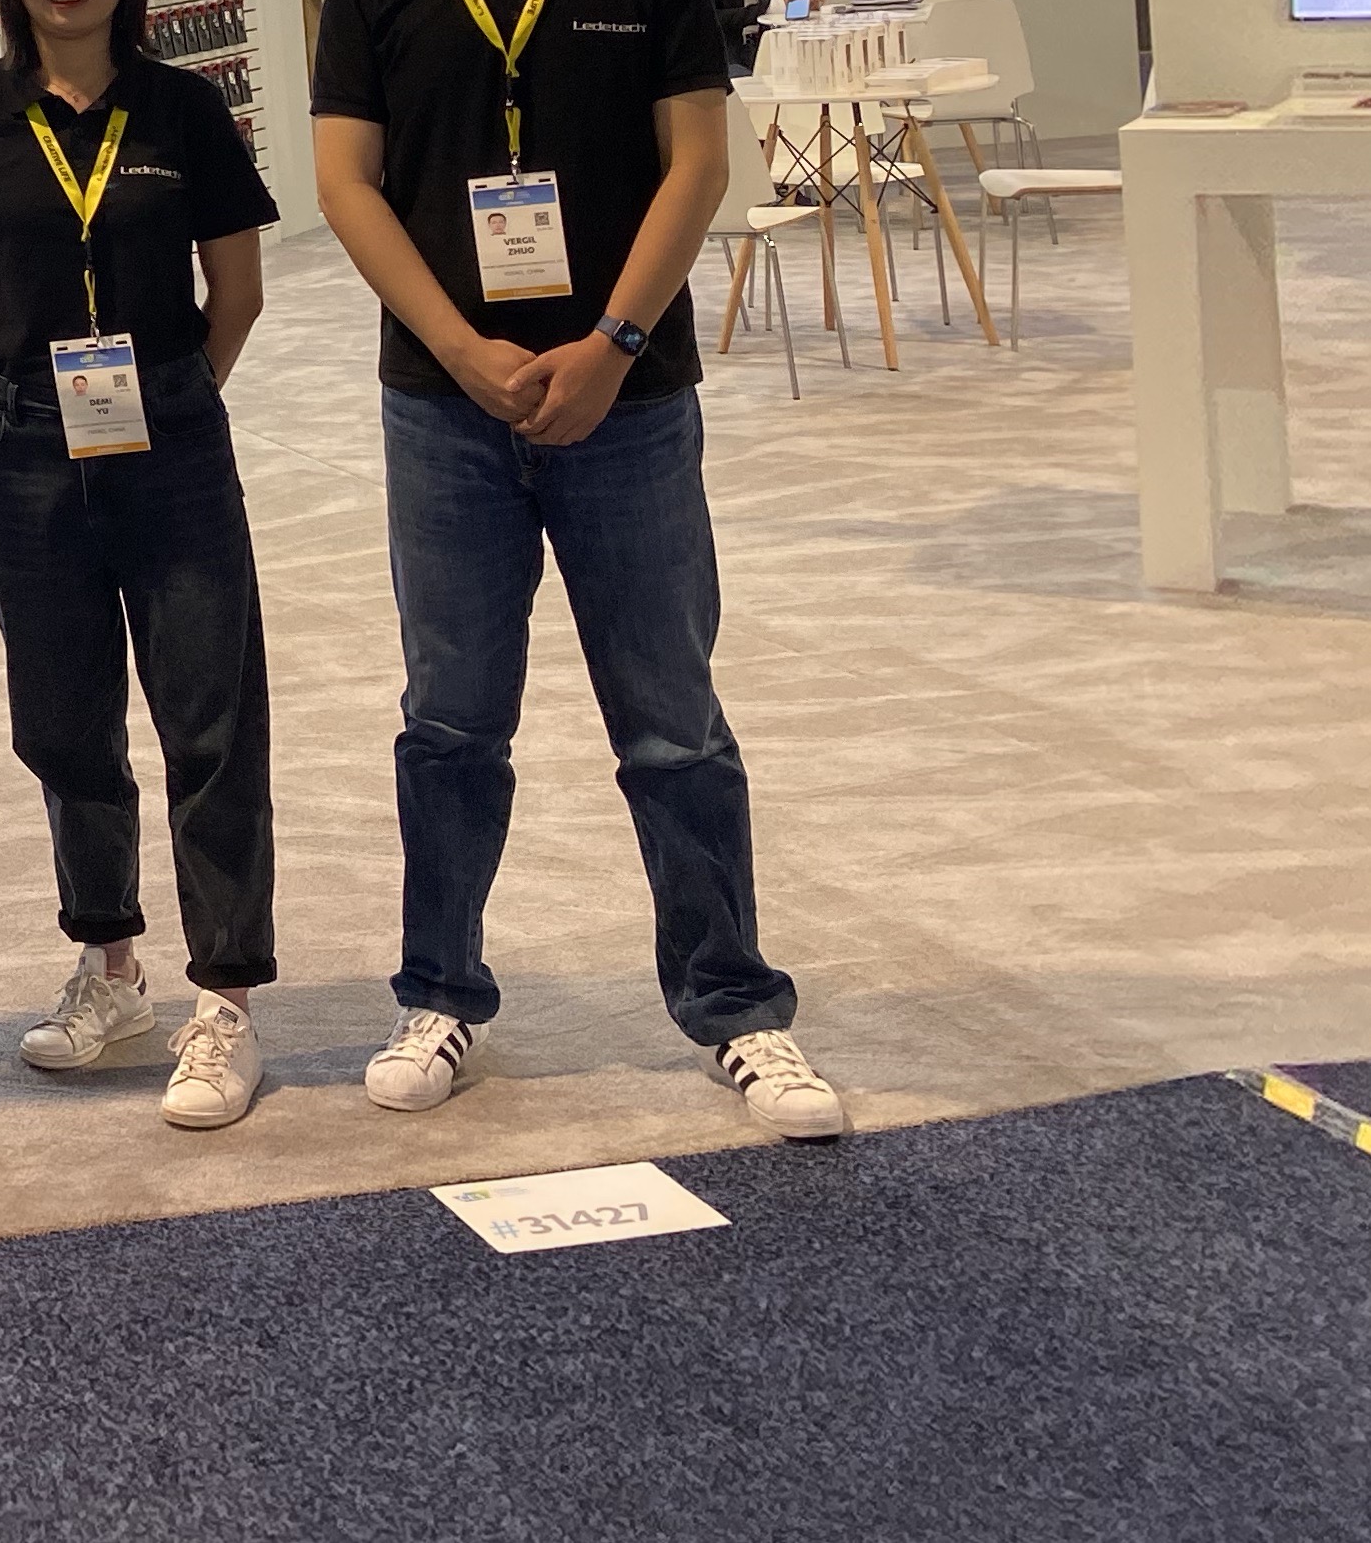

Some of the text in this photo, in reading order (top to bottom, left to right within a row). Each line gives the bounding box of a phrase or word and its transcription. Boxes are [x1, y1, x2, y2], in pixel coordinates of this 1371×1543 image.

[572, 19, 648, 34] Ledetech
[503, 235, 538, 246] VERGIL
[508, 246, 535, 256] ZHUO
[488, 1201, 649, 1241] #31427
